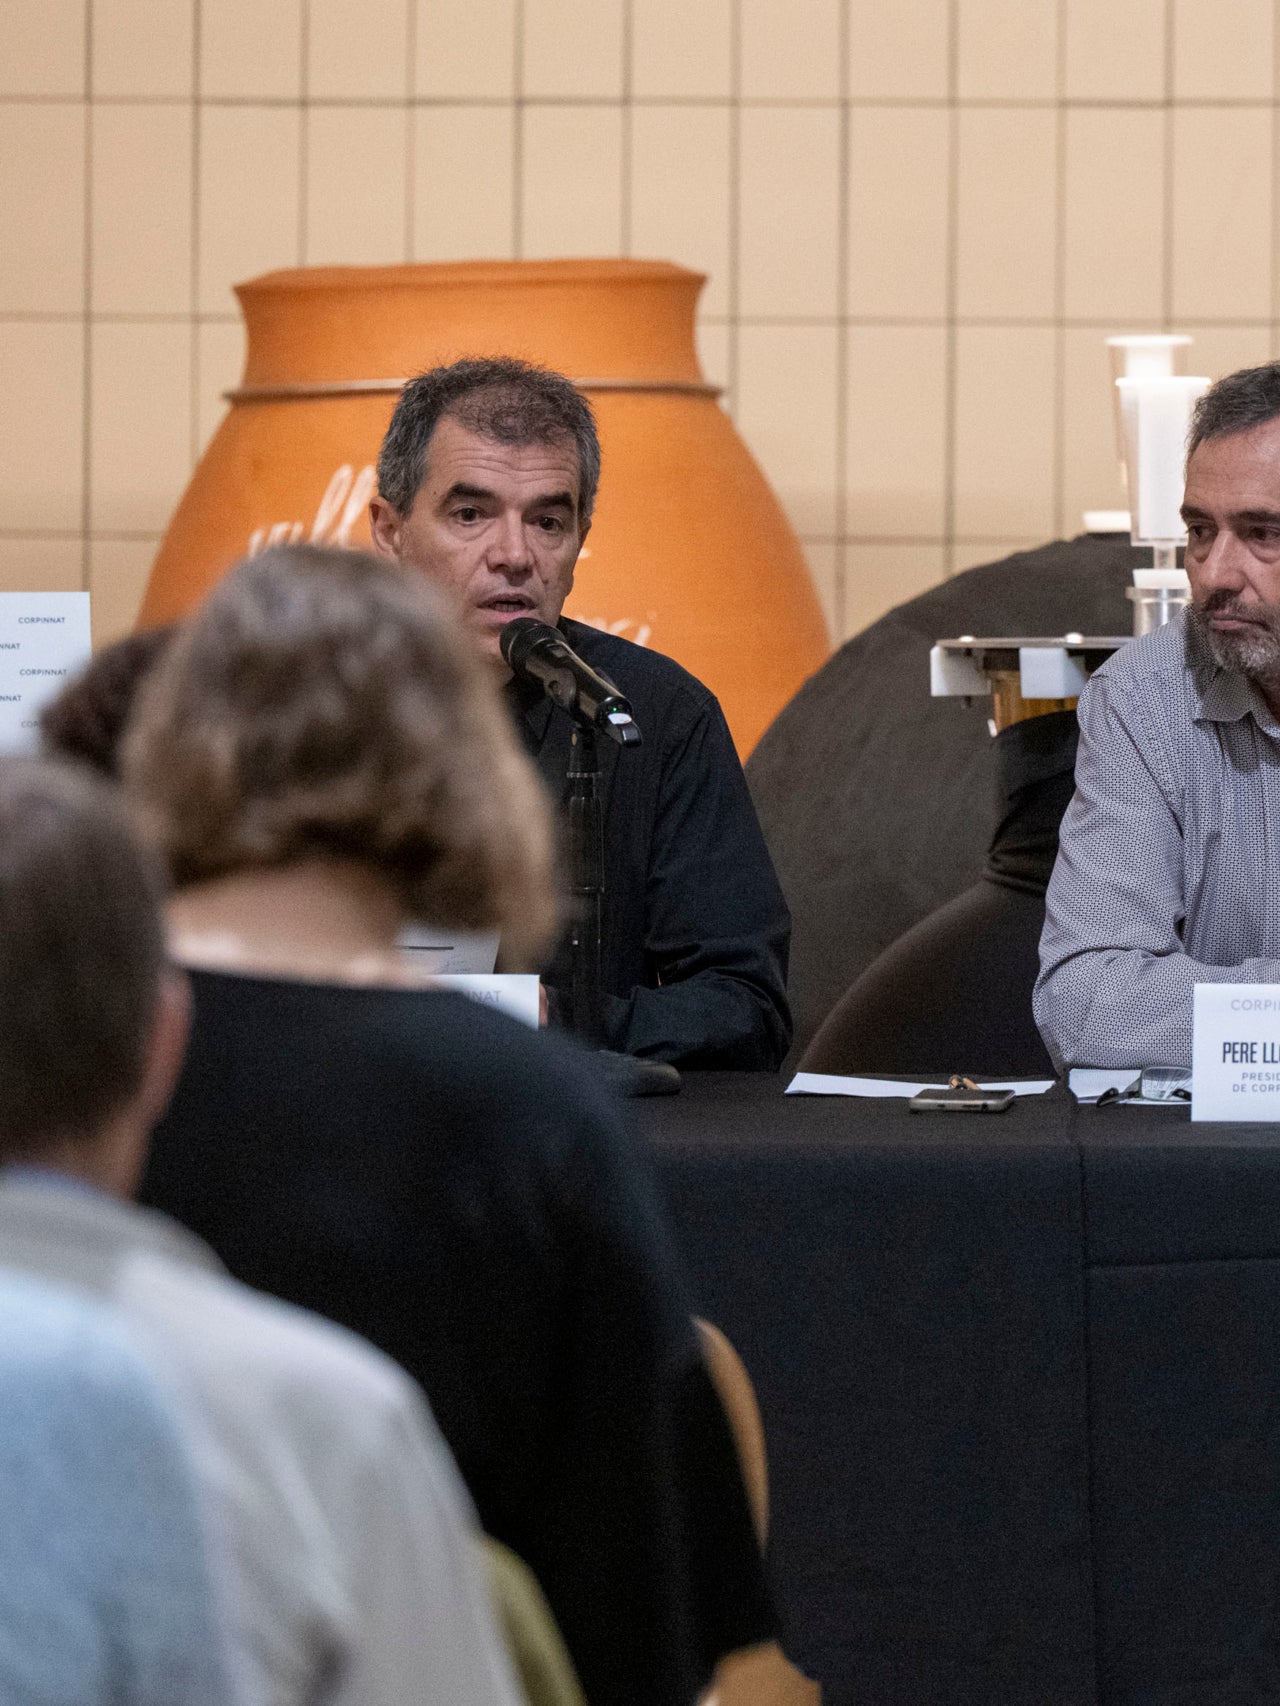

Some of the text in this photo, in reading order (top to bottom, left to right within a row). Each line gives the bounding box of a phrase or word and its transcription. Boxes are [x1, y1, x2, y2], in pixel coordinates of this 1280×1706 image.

[18, 616, 66, 625] CORPINNAT
[19, 668, 67, 676] CORPINNAT
[1222, 1041, 1258, 1064] PERE
[1232, 1083, 1247, 1093] DE
